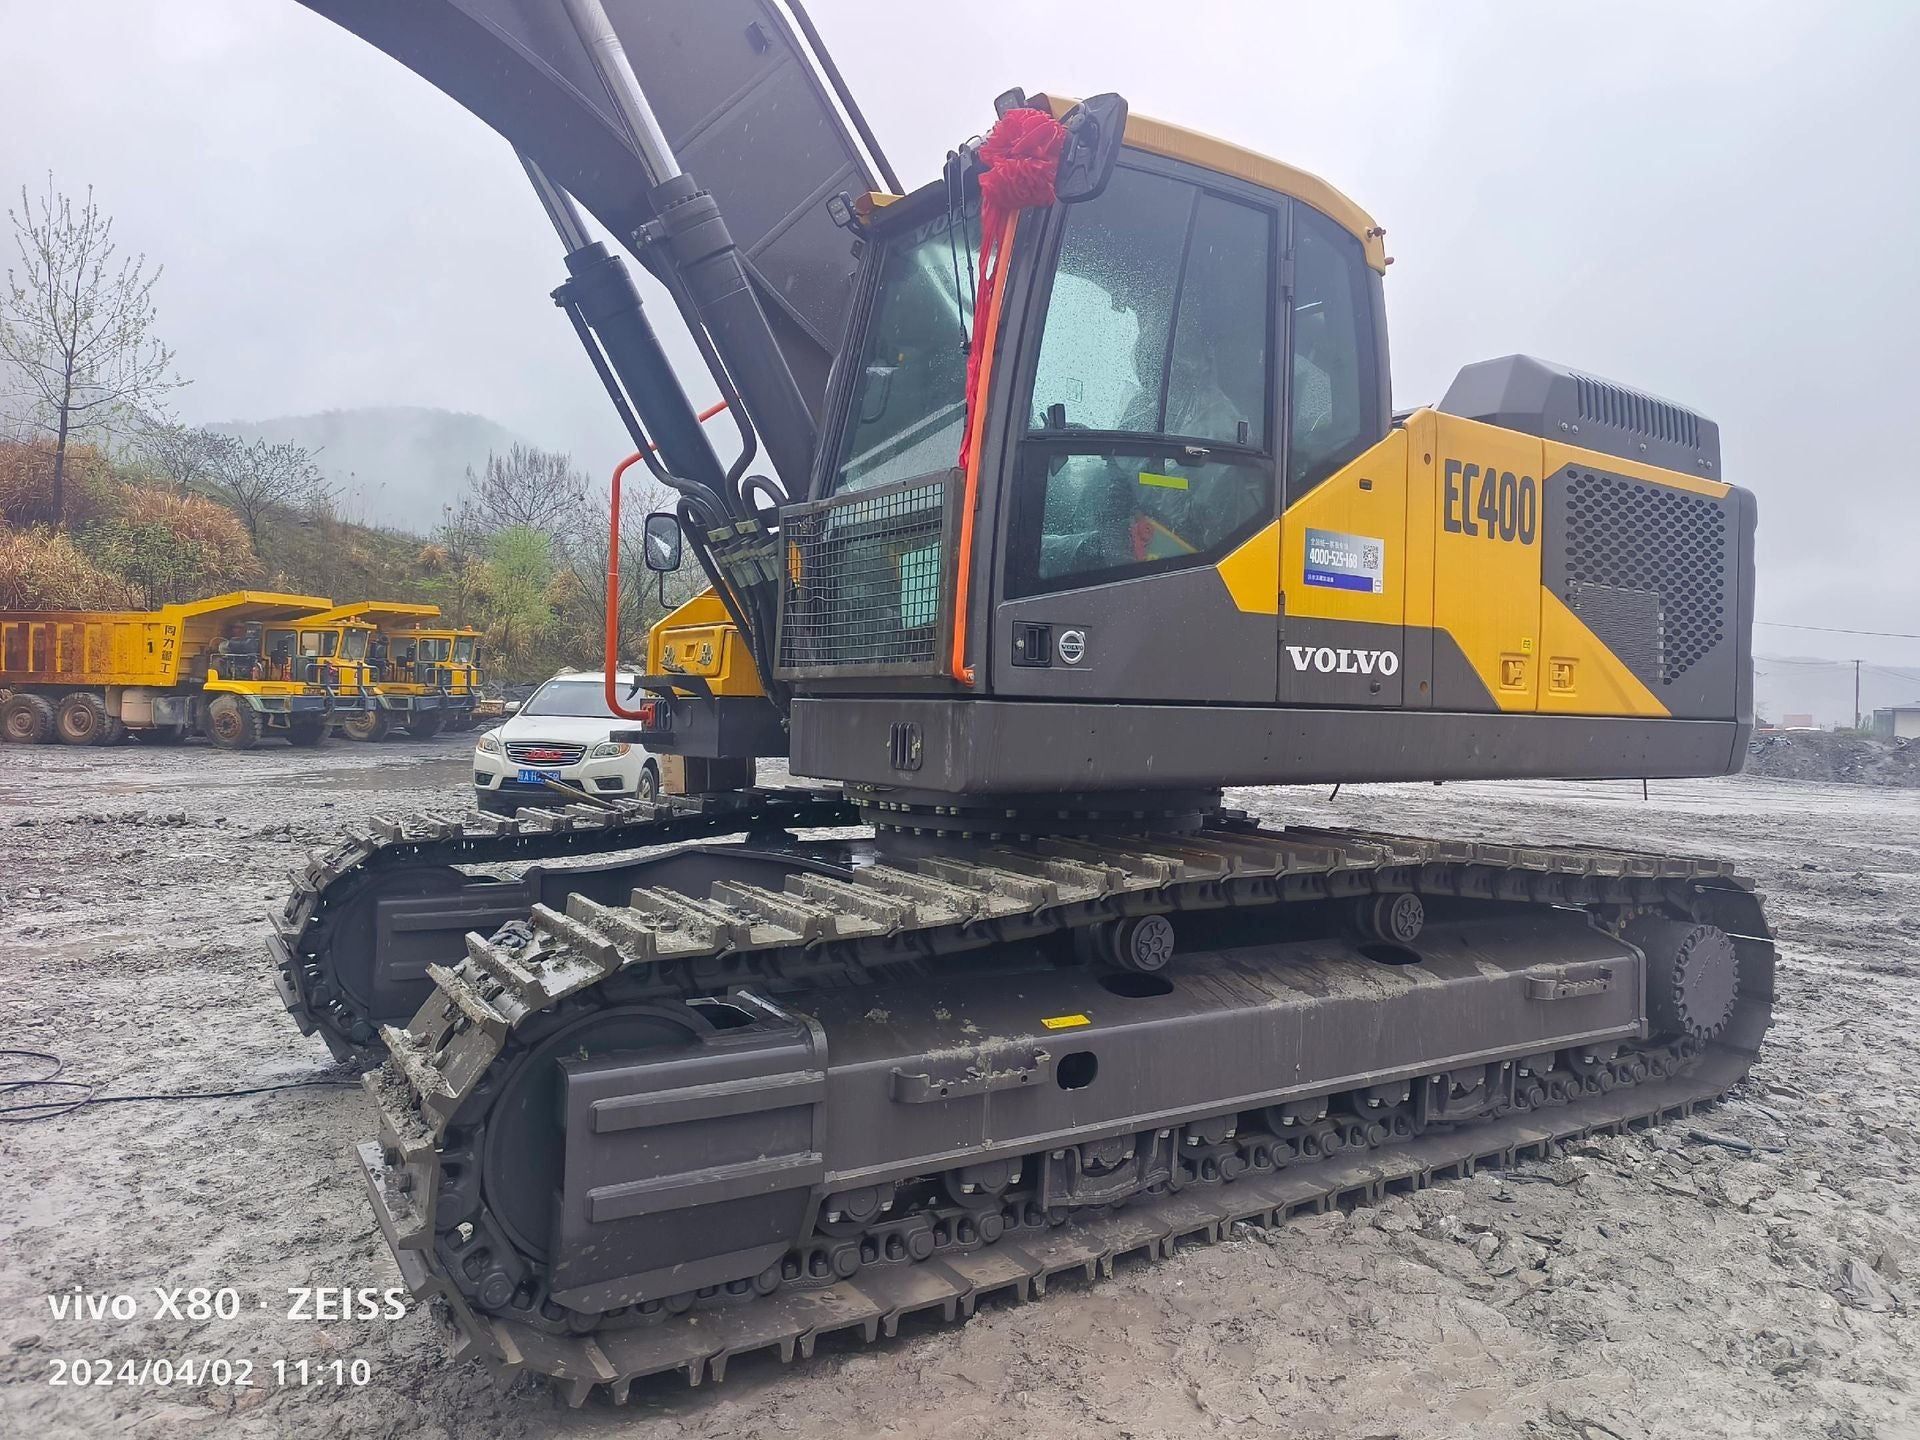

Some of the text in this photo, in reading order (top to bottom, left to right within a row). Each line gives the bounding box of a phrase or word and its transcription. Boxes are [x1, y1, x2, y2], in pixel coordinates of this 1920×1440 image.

[1444, 458, 1536, 545] EC400
[1309, 547, 1358, 568] 4000-525-168
[1286, 646, 1399, 676] VOLVO
